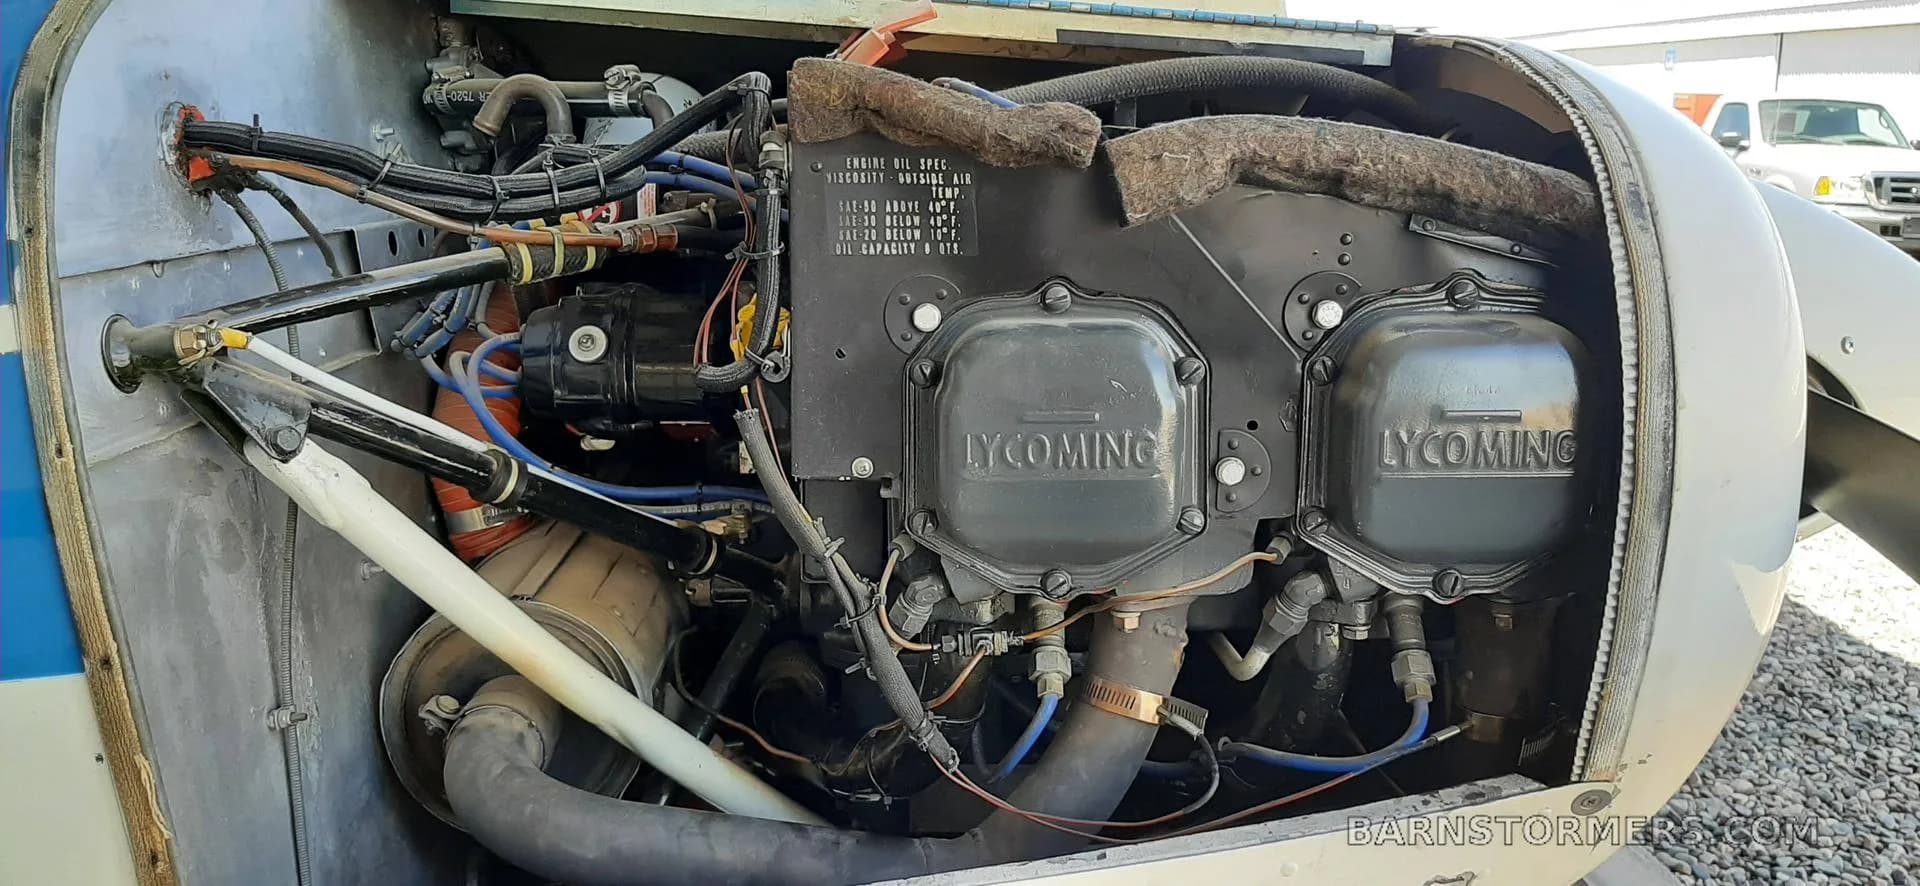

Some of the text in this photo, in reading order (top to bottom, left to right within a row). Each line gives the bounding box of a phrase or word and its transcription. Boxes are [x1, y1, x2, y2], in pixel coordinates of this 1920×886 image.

[894, 158, 911, 169] OIL
[920, 158, 952, 170] SPEC.
[826, 172, 885, 184] VISCOSITY
[898, 174, 944, 185] OUTSIDE
[953, 174, 972, 184] AIR
[932, 187, 965, 199] TEMP.
[886, 201, 920, 213] ABOVE
[886, 215, 921, 227] BELOW
[839, 229, 877, 241] SAE-20
[886, 229, 921, 241] BELOW
[836, 243, 852, 255] OIL
[862, 242, 915, 255] CAPACITY
[966, 432, 1158, 468] LYCOMING
[1380, 430, 1577, 468] LYCOMING
